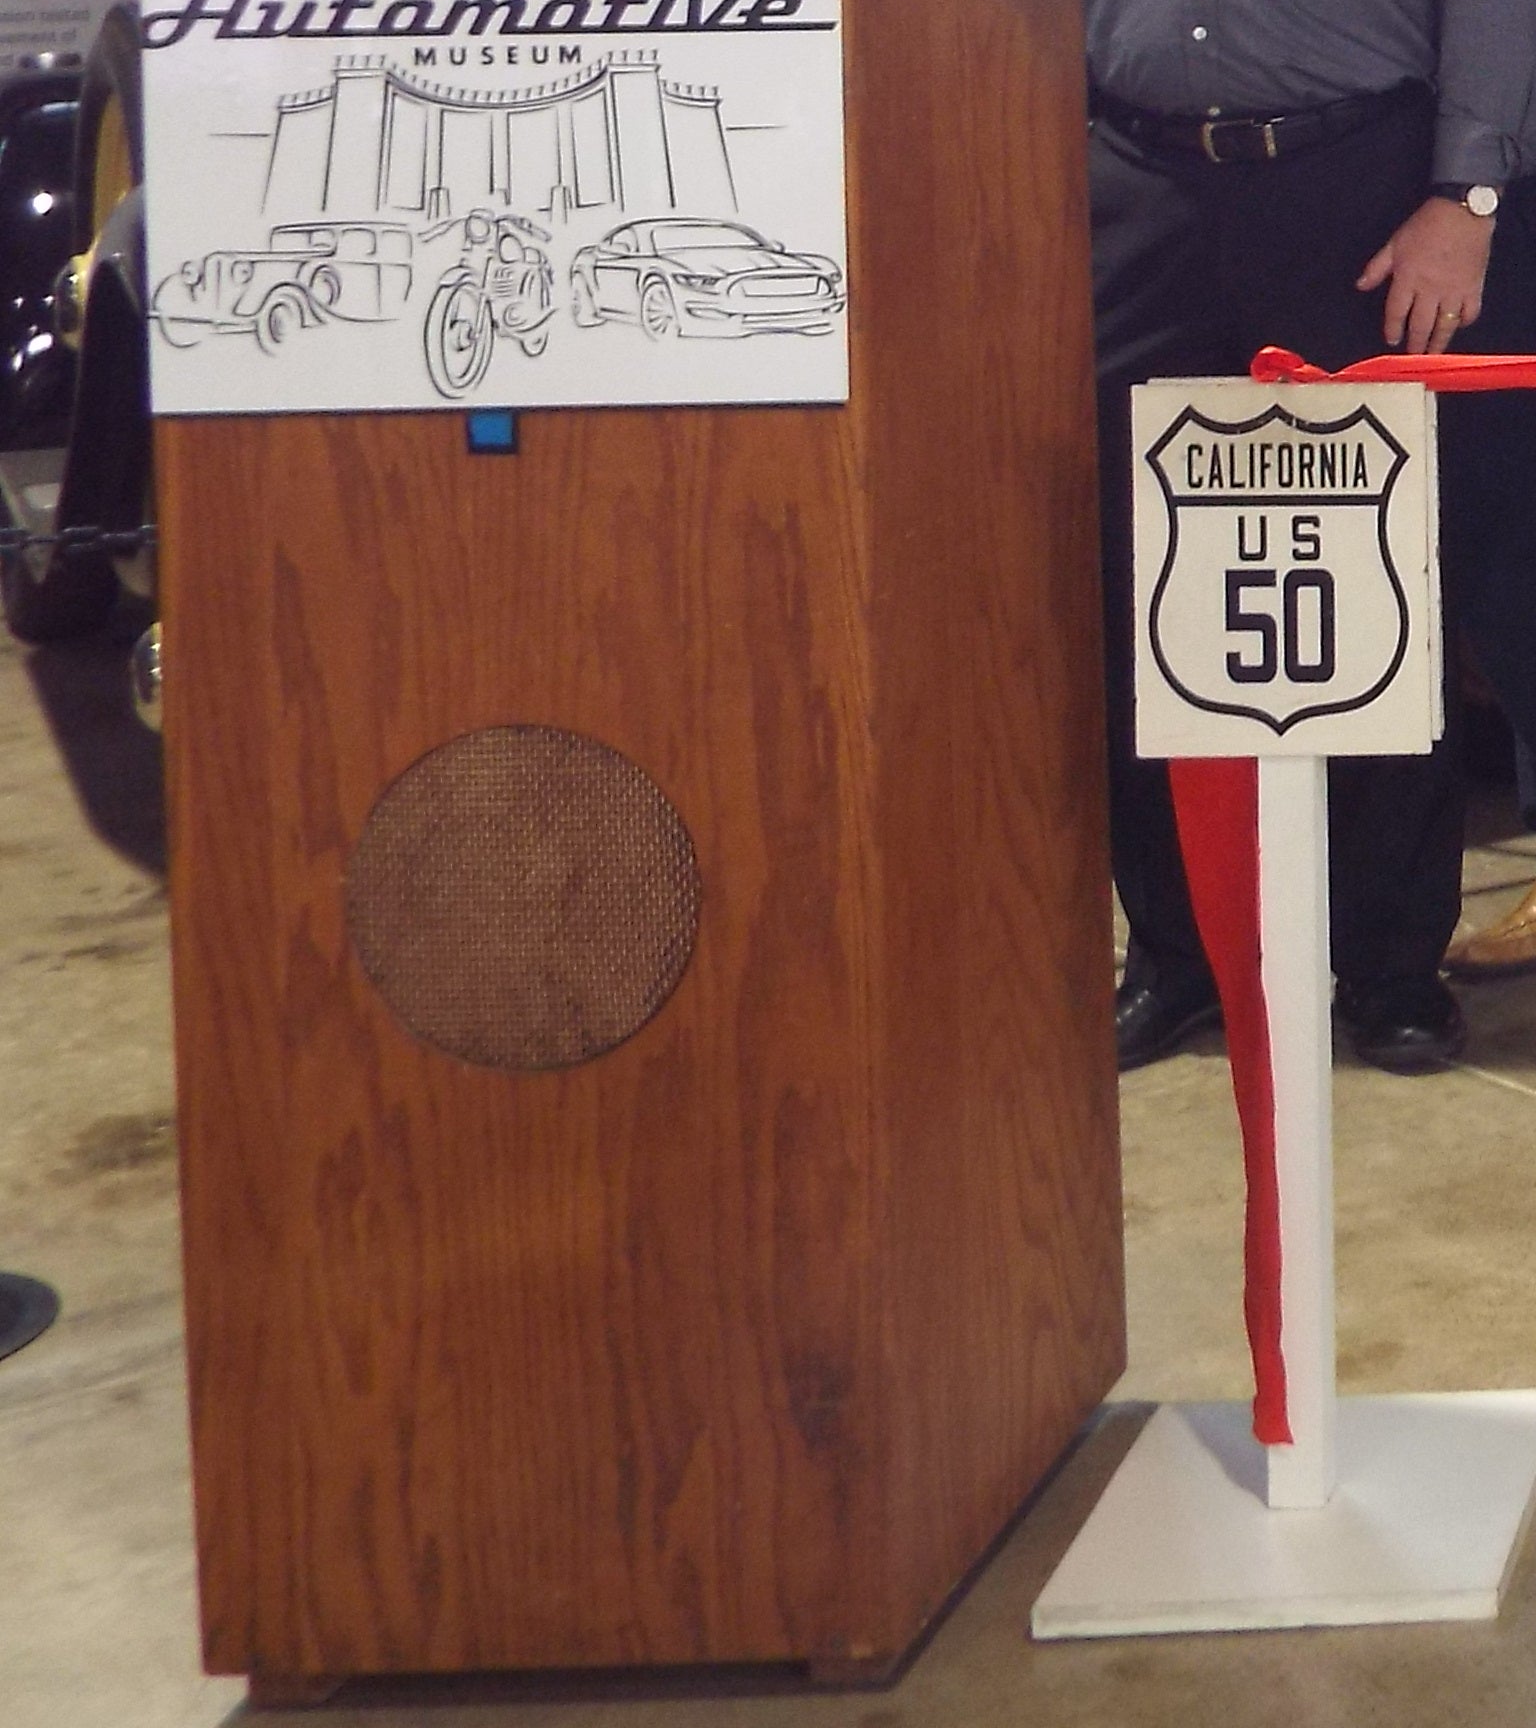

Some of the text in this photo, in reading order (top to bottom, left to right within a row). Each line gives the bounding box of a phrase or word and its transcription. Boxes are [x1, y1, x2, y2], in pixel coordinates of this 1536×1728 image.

[413, 45, 583, 66] MUSEUM
[1186, 441, 1369, 490] CALIFORNIA
[1224, 568, 1336, 684] 50
